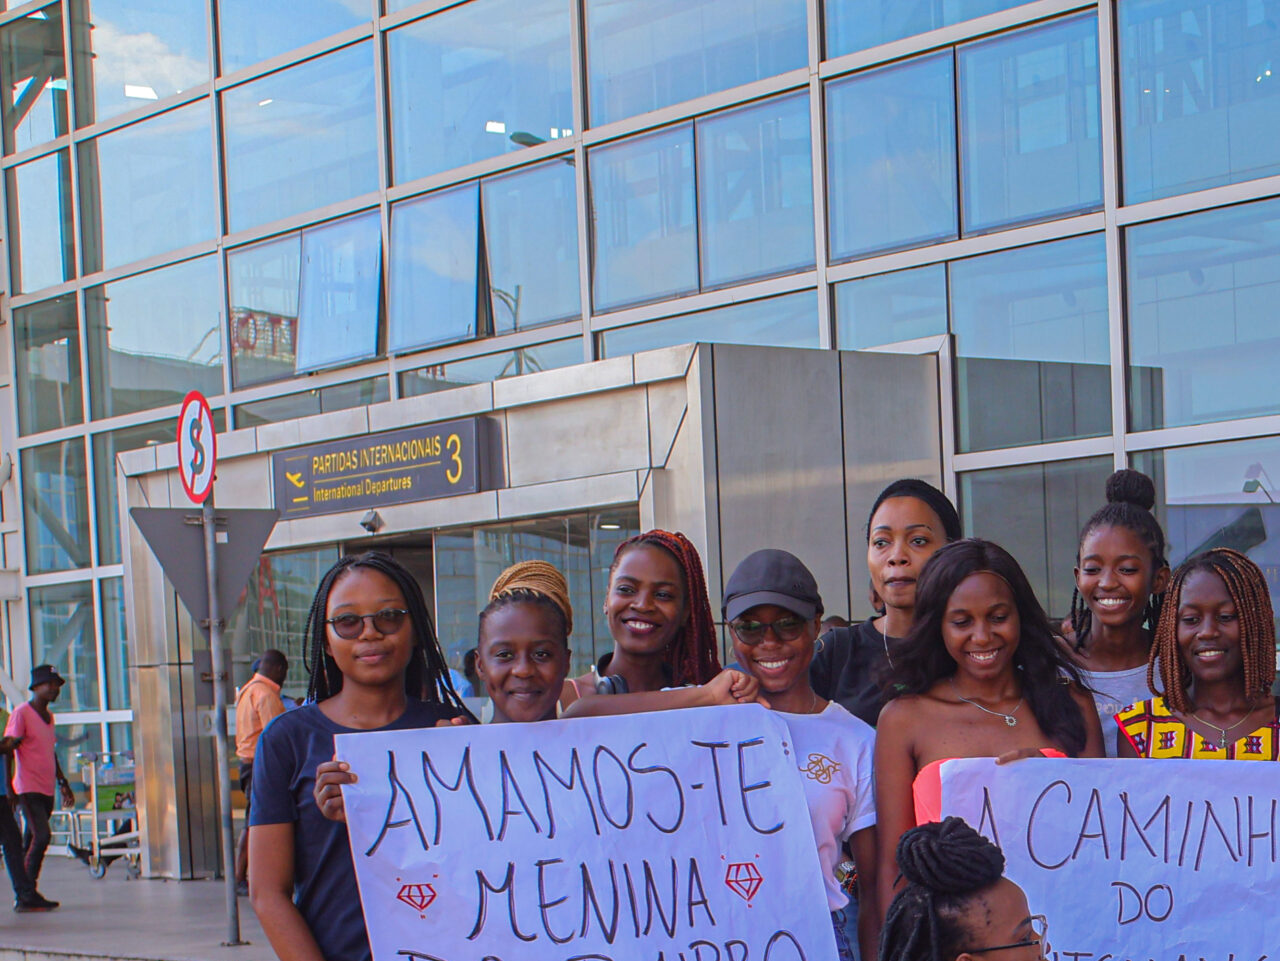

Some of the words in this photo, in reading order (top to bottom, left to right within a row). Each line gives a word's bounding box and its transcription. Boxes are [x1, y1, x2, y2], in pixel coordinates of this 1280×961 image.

[312, 450, 358, 476] PARTIDAS
[360, 435, 441, 468] INTERNACIONAIS
[446, 433, 463, 484] 3
[313, 482, 364, 503] International
[366, 475, 412, 497] Departures
[366, 736, 785, 857] AMAMOS-TE
[466, 856, 717, 945] MENINA
[1111, 881, 1174, 926] DO
